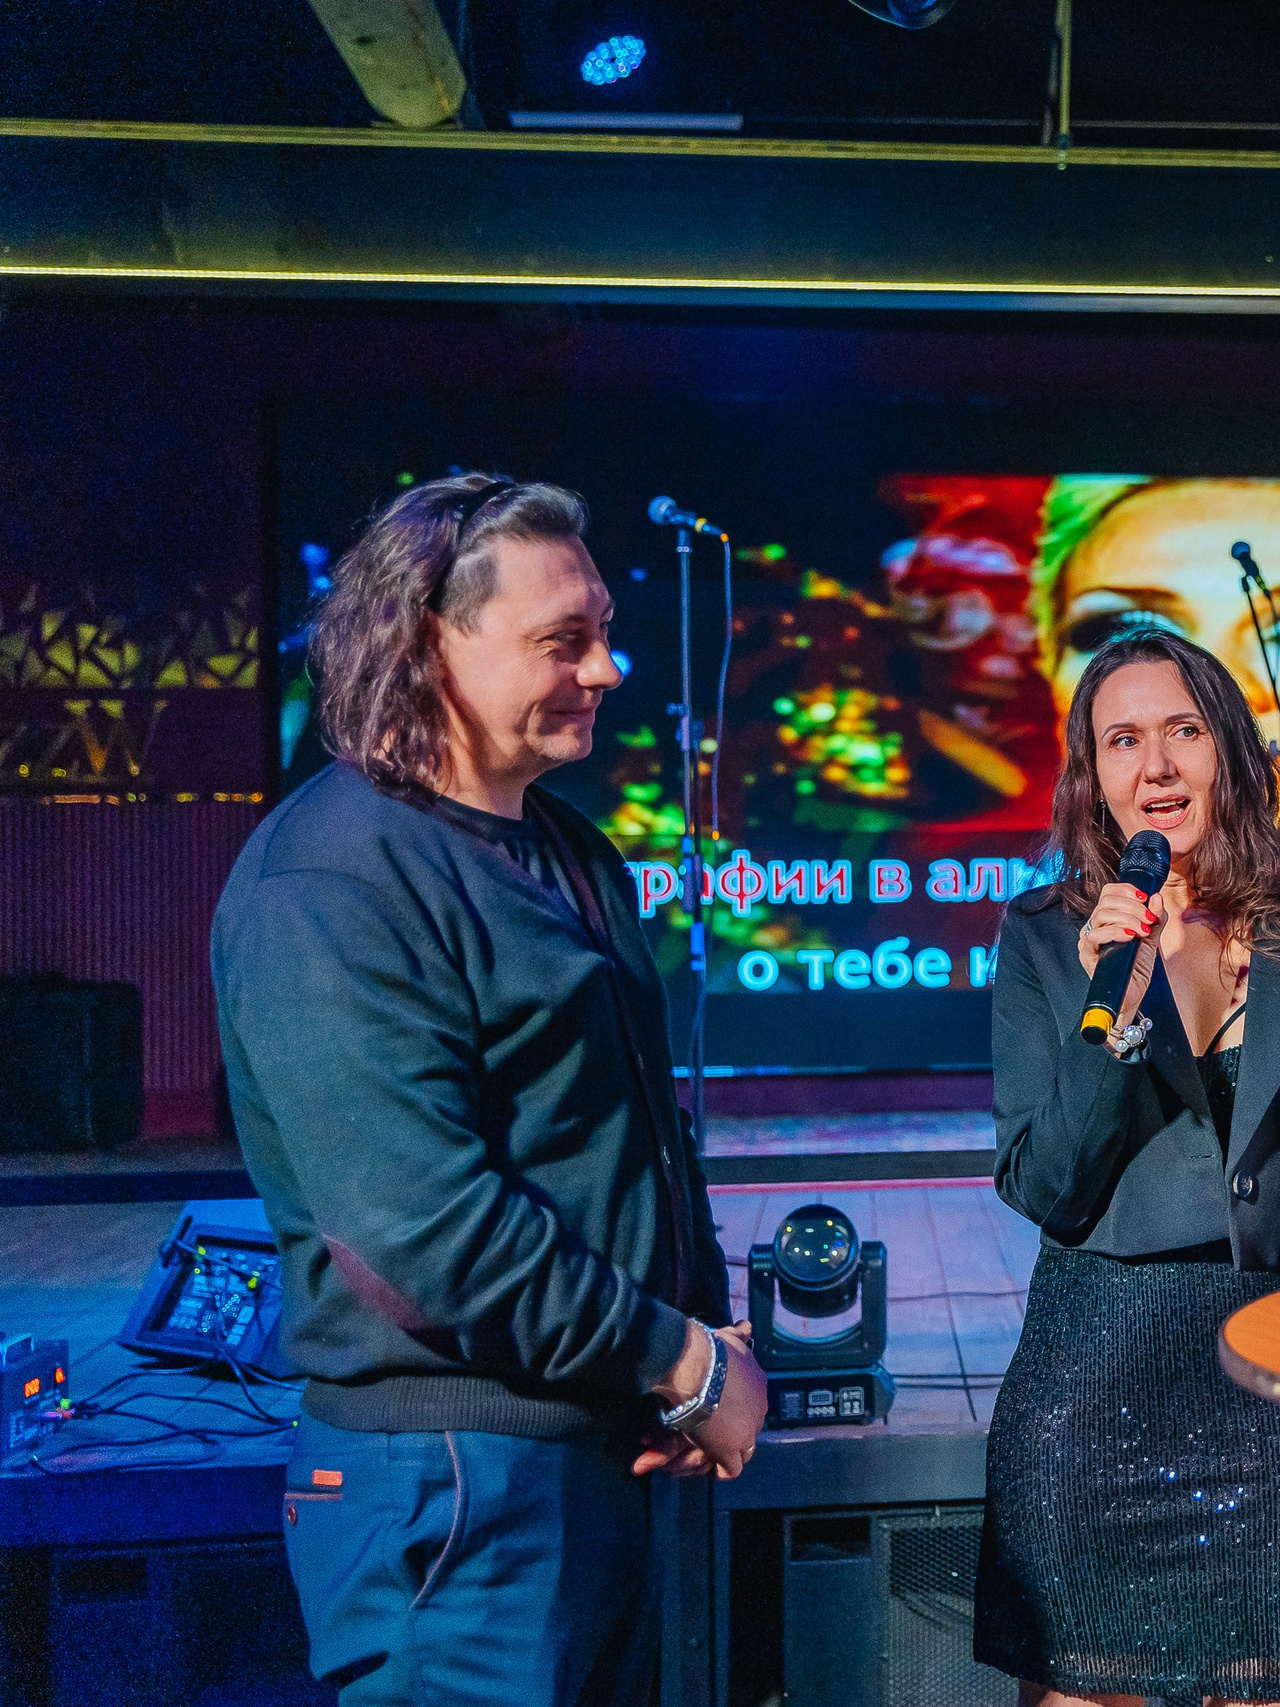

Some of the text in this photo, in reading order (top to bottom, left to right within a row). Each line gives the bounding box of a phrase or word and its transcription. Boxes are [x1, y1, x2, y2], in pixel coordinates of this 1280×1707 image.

[869, 860, 912, 903] в
[737, 950, 779, 991] о
[796, 936, 952, 989] тебе
